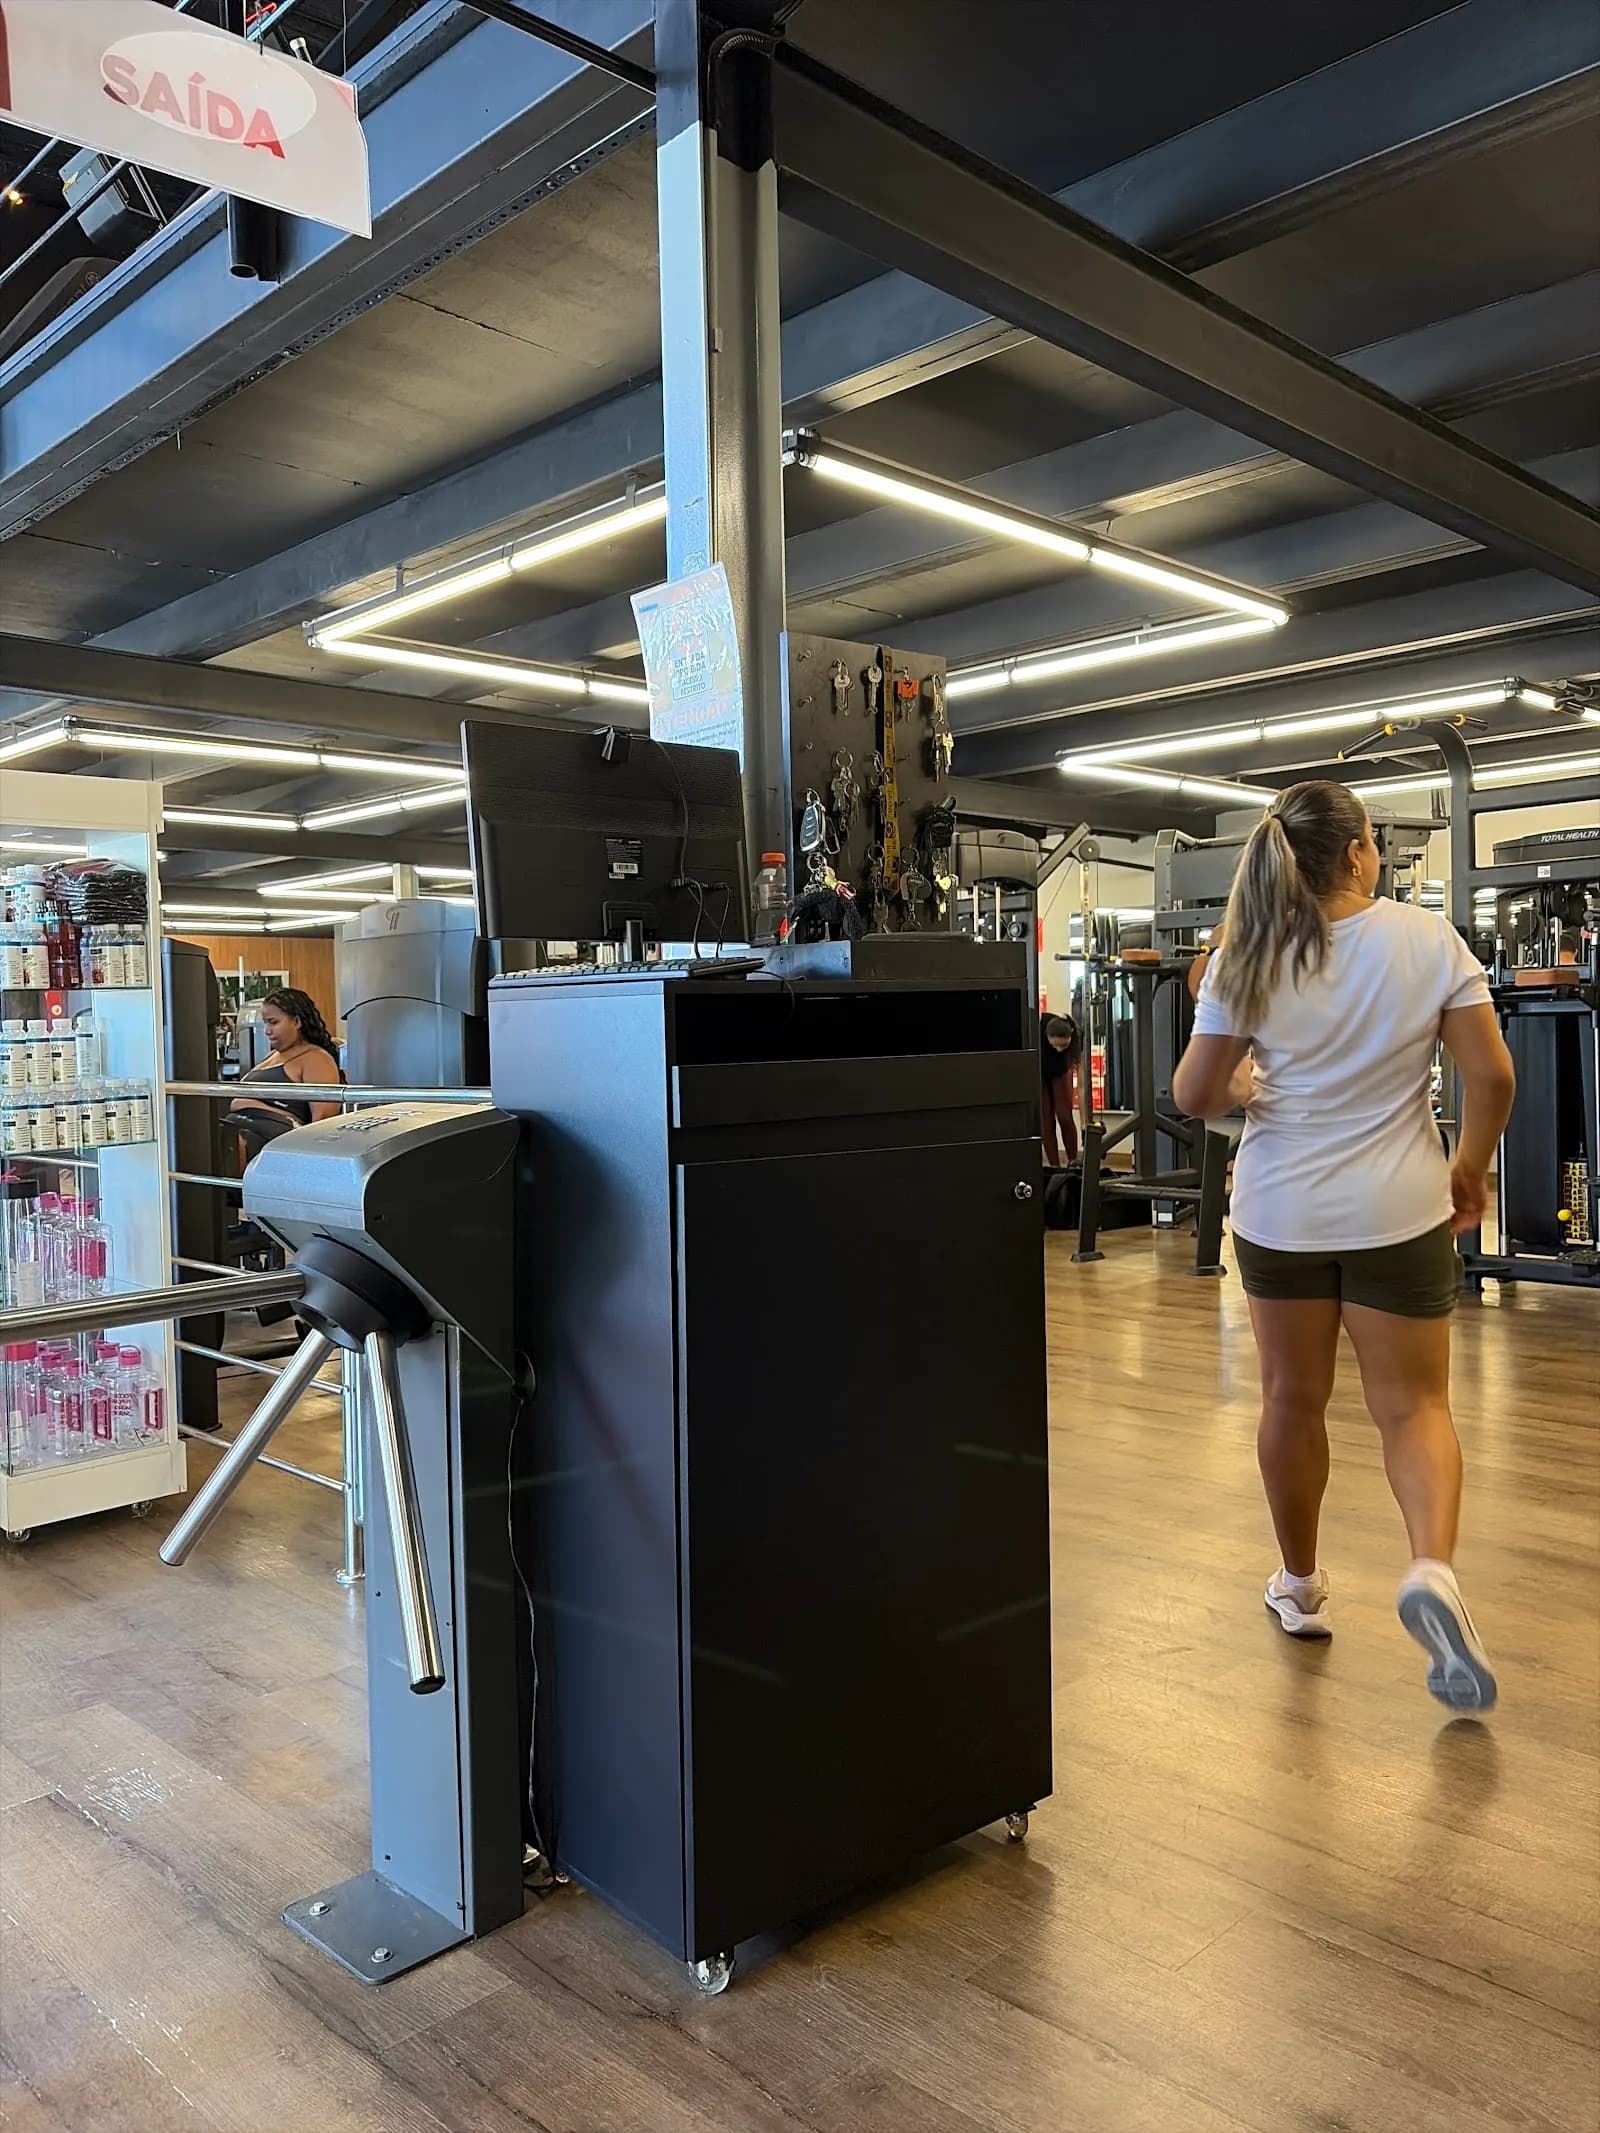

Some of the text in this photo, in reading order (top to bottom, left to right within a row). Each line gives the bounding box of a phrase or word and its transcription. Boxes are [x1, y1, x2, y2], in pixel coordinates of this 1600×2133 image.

[102, 54, 286, 159] SAÍDA
[1541, 830, 1600, 843] TOTAL HEALTH
